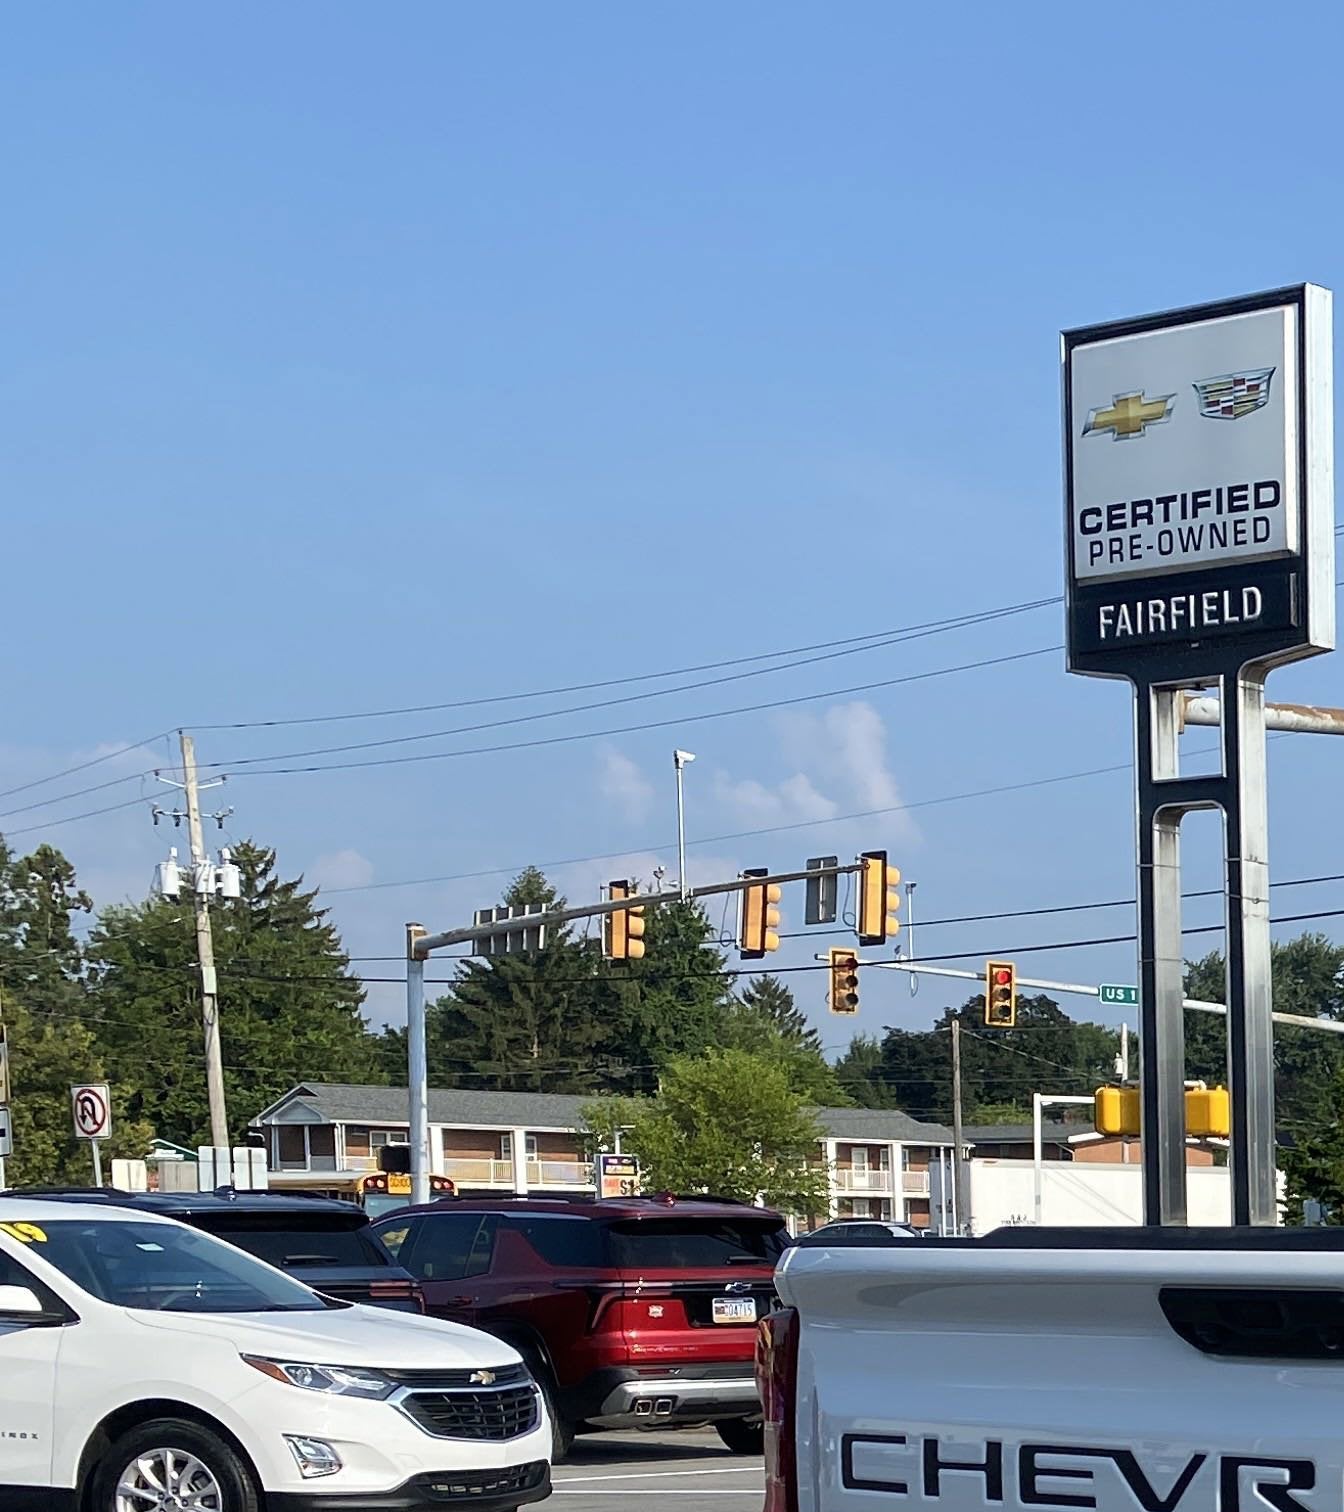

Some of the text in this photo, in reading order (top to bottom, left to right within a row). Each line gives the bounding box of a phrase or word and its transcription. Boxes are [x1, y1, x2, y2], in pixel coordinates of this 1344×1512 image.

[1080, 480, 1280, 535] CERTIFIED
[1090, 516, 1270, 566] PRE-OWNED
[1099, 586, 1262, 639] FAIRFIELD
[1106, 988, 1125, 1000] US
